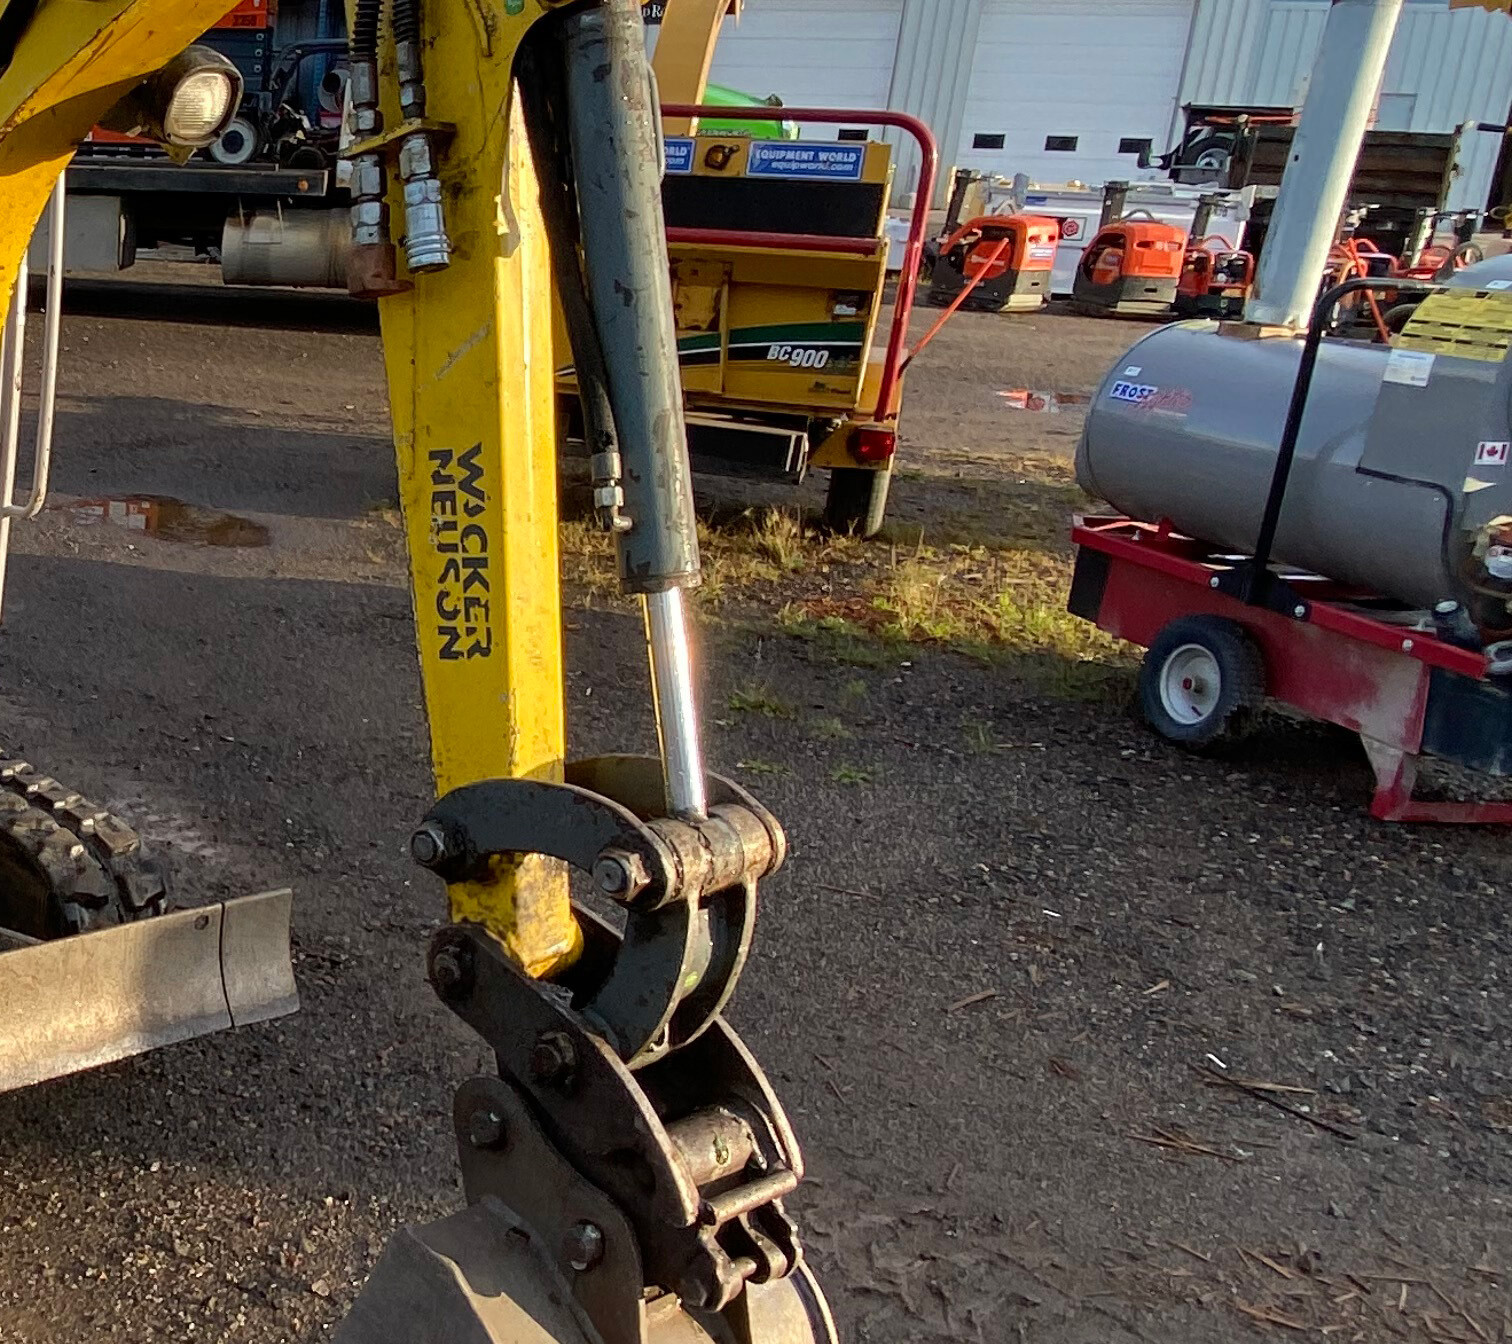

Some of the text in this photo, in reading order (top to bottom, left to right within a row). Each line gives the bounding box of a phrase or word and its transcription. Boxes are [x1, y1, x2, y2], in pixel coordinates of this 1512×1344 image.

[818, 152, 856, 162] WORLD
[767, 344, 829, 368] BC900
[1112, 383, 1155, 399] FROST
[428, 449, 465, 660] NEUSON
